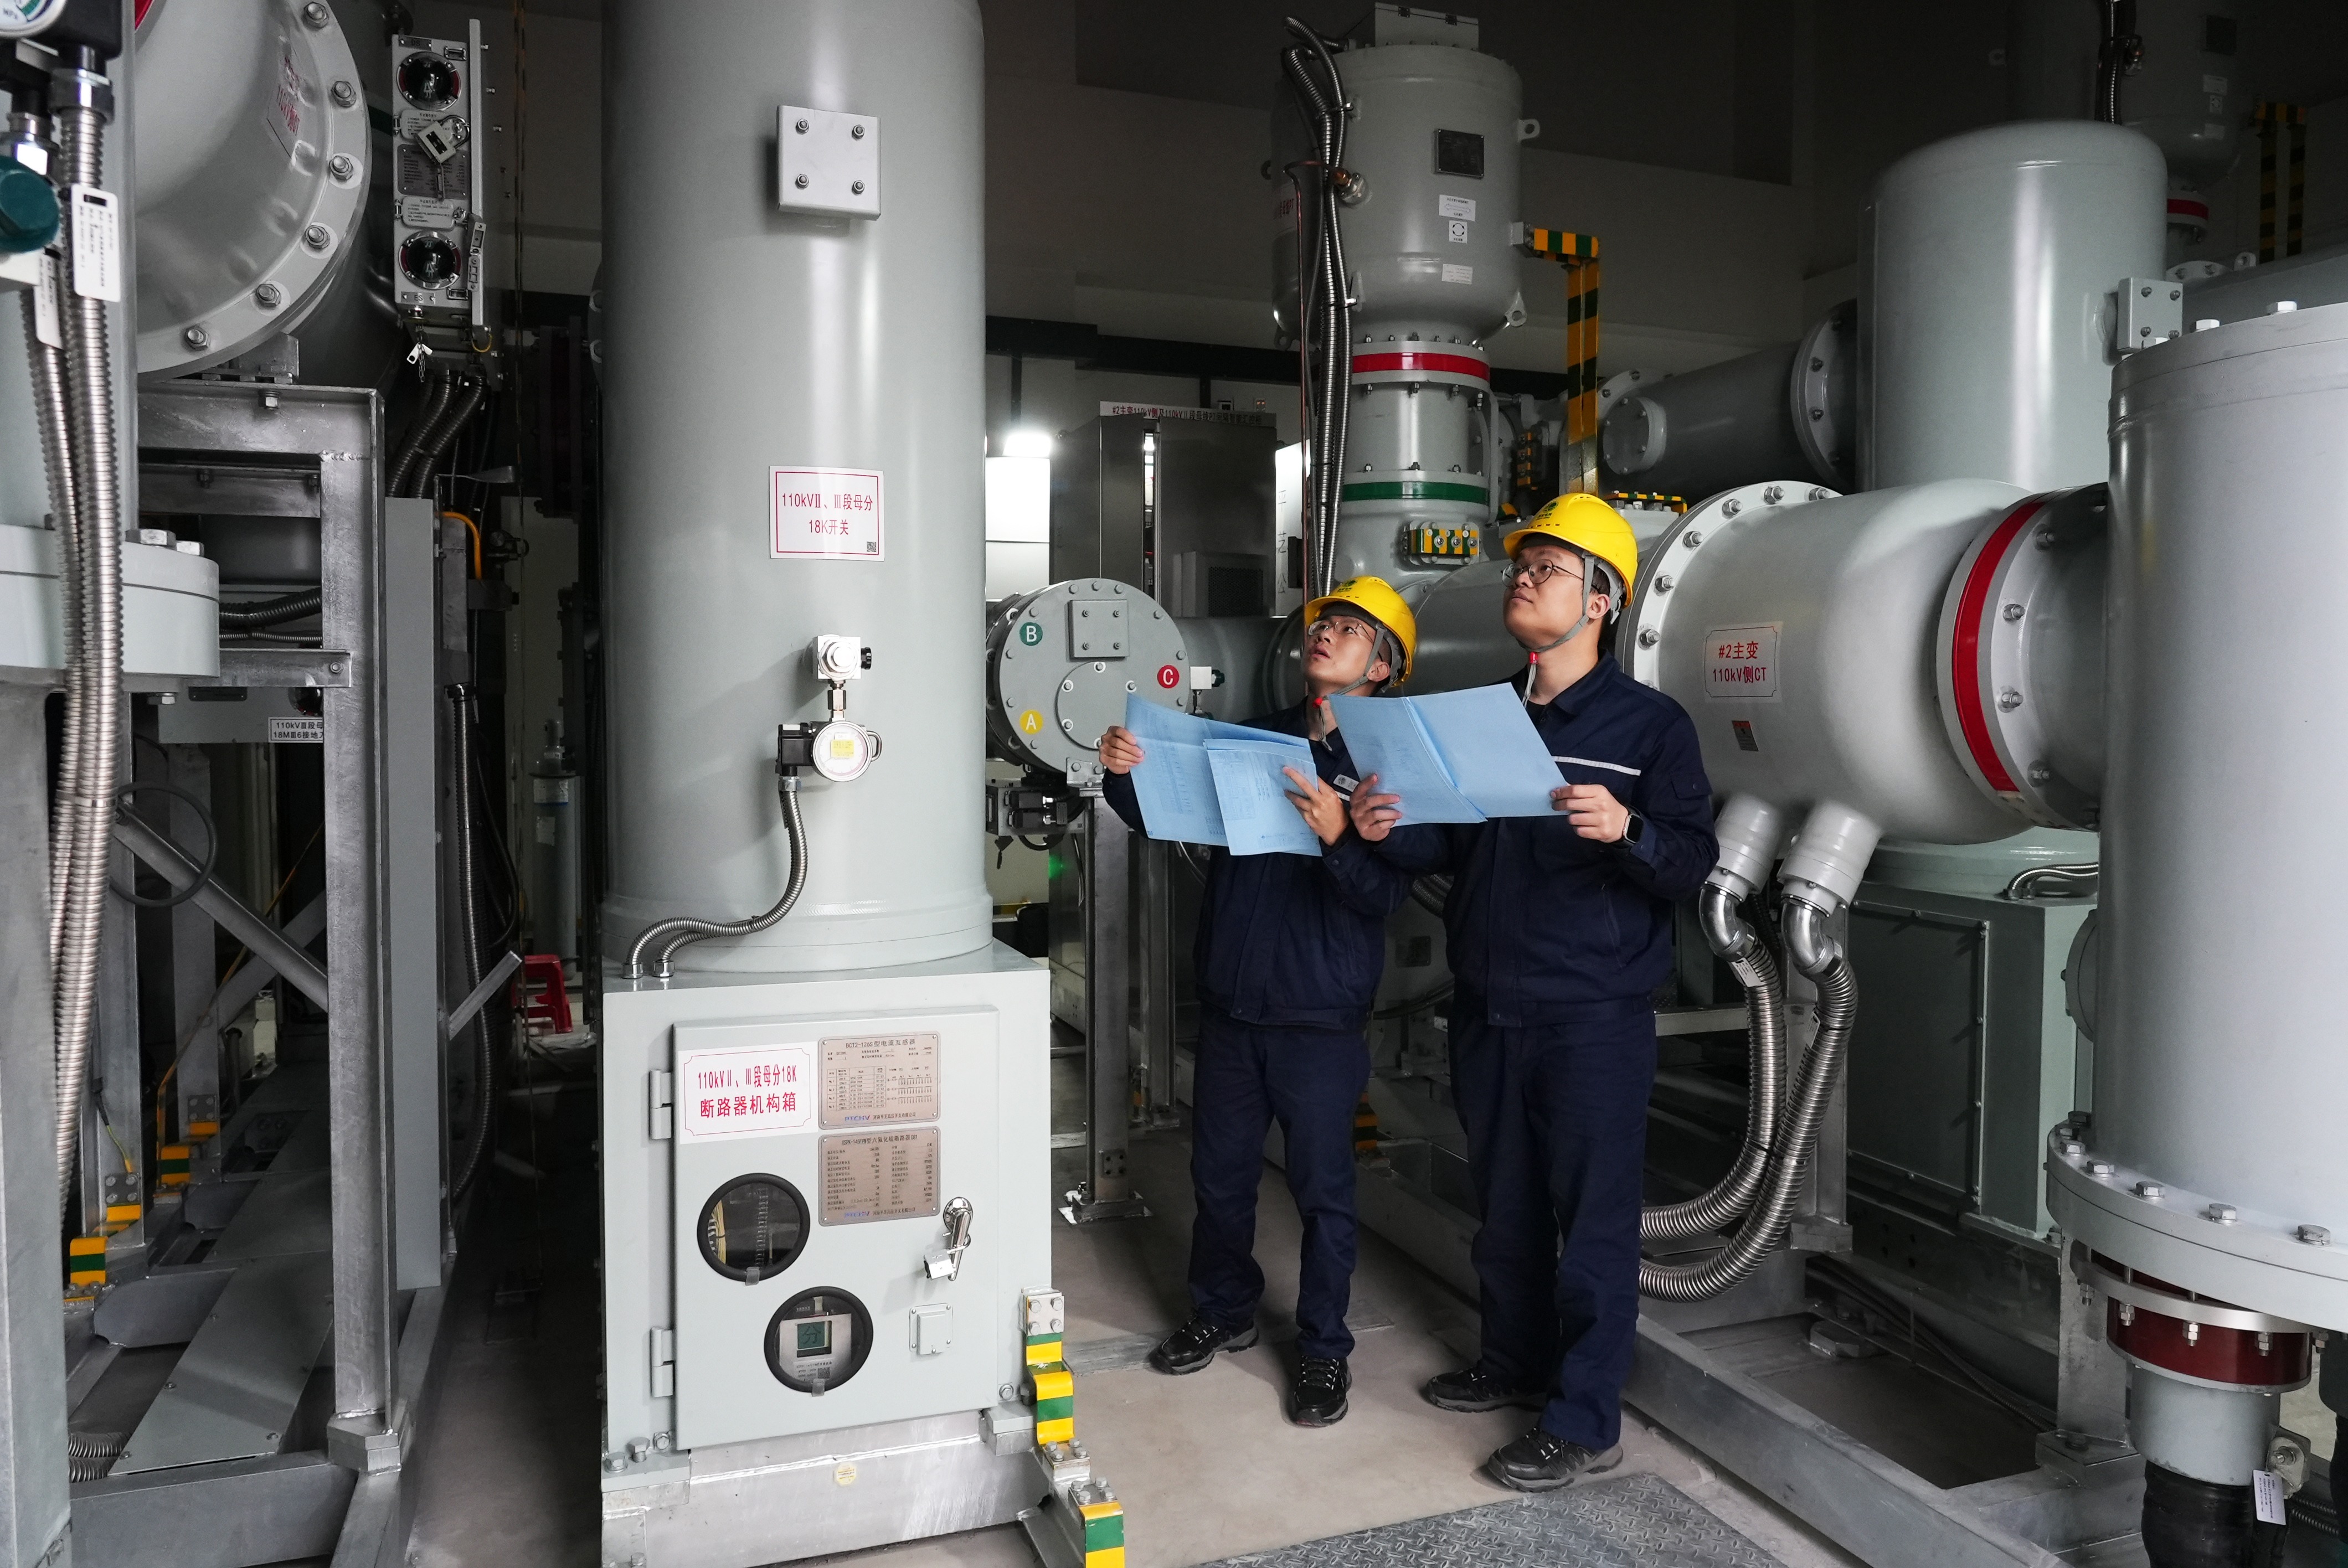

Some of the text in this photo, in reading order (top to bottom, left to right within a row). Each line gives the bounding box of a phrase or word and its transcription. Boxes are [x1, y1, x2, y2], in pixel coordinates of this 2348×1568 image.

[809, 519, 849, 535] 18K开关
[1026, 626, 1037, 642] B
[1718, 641, 1759, 659] #2主变
[1163, 669, 1173, 685] C
[1713, 666, 1767, 684] 110kV侧CT
[1026, 714, 1037, 730] A
[701, 1091, 796, 1118] 断路器机构箱
[804, 1325, 821, 1344] 分
